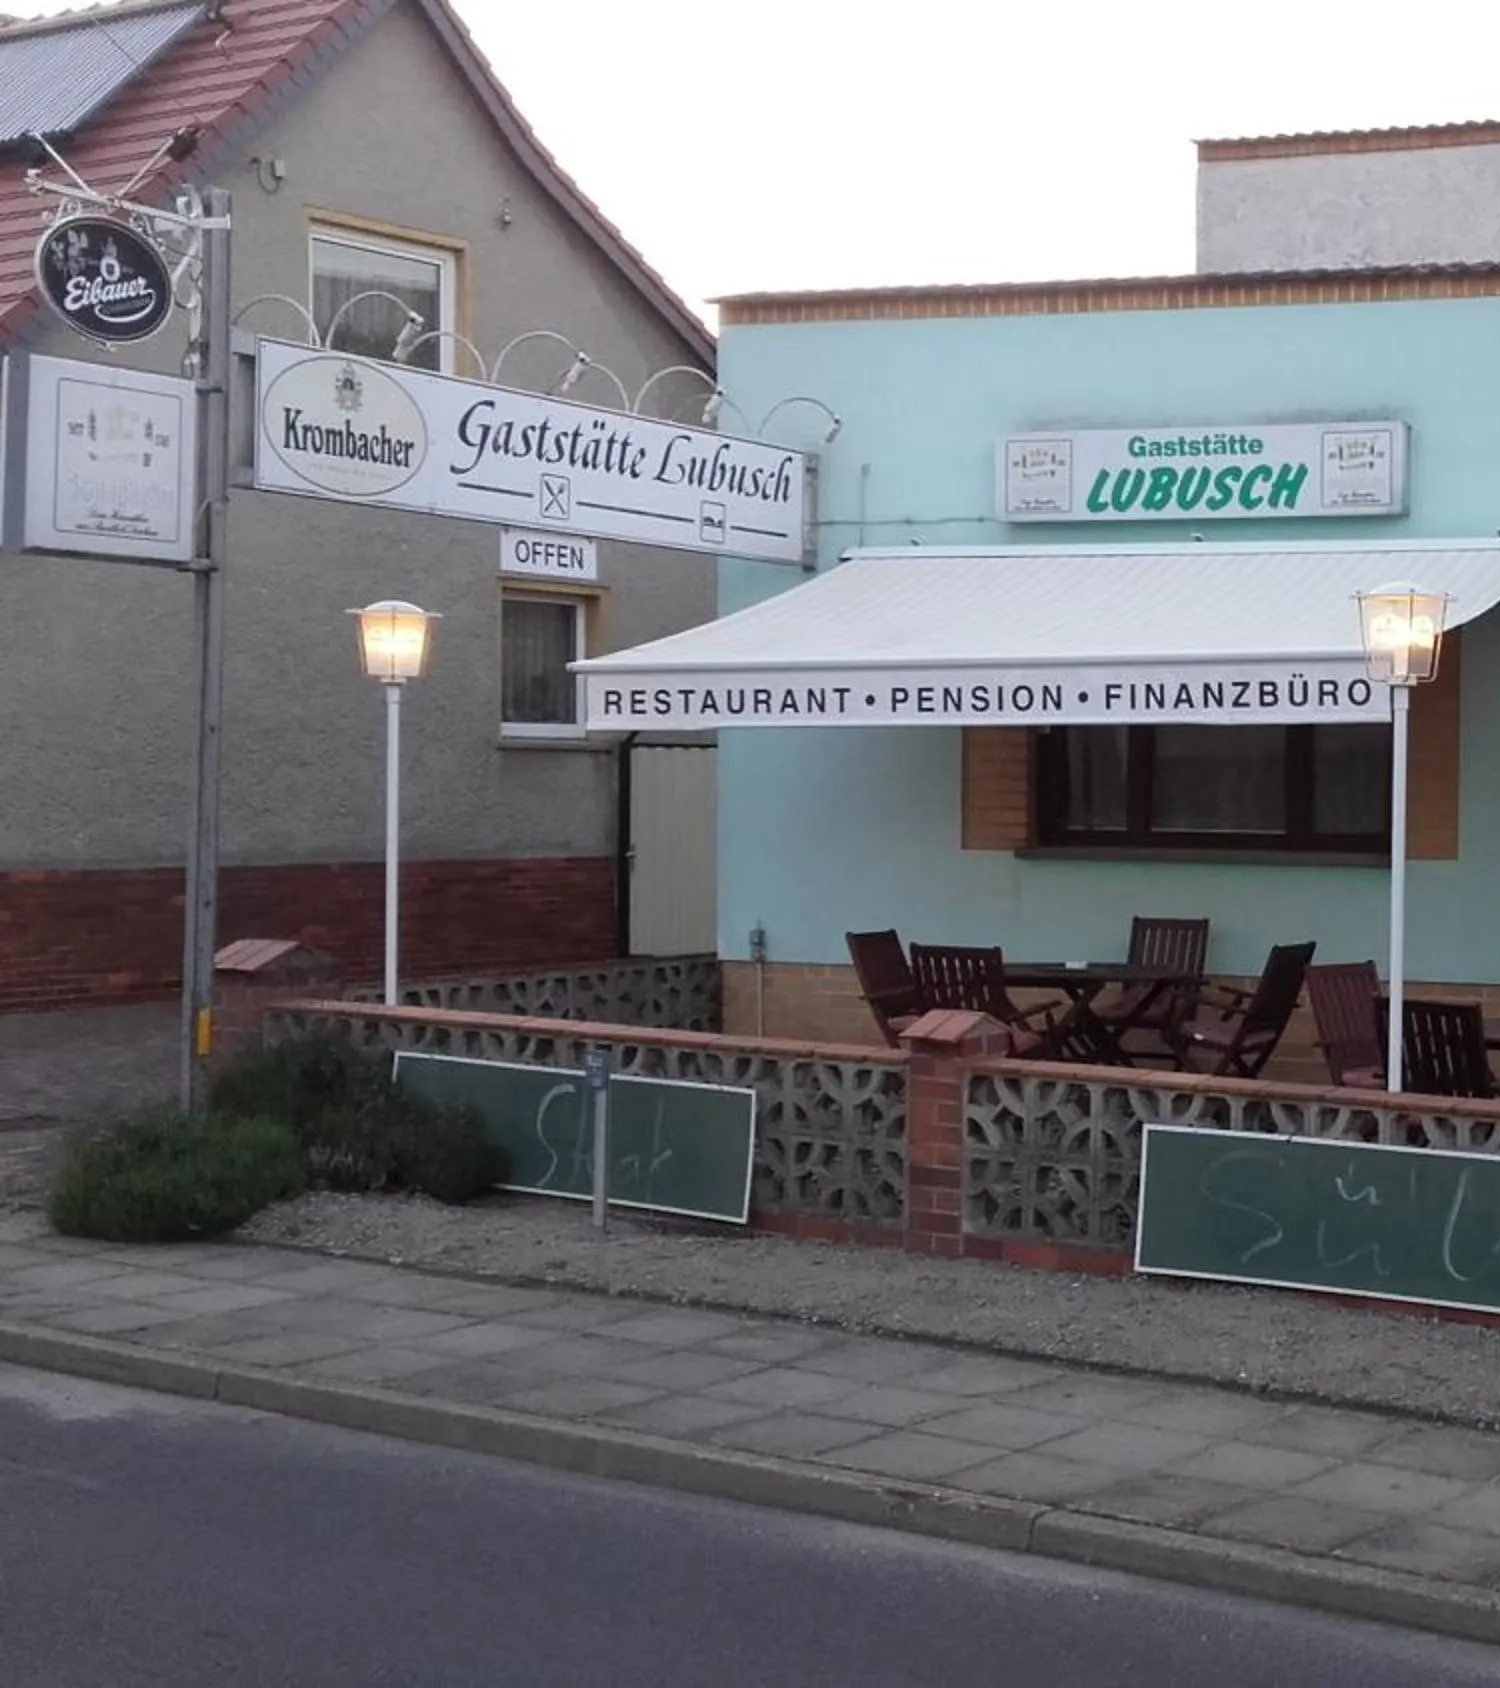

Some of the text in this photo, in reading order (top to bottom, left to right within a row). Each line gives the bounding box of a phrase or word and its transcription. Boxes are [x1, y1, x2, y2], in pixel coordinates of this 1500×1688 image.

[64, 275, 150, 312] Eibauer
[283, 406, 415, 468] Krombacher
[449, 400, 793, 503] Gaststätte Lubusch
[1127, 434, 1264, 458] Gaststätte
[1085, 462, 1309, 513] LUBUSCH
[515, 540, 584, 570] OFFEN
[604, 673, 1372, 715] RESTAURANT PENSION FINANZBÜRO
